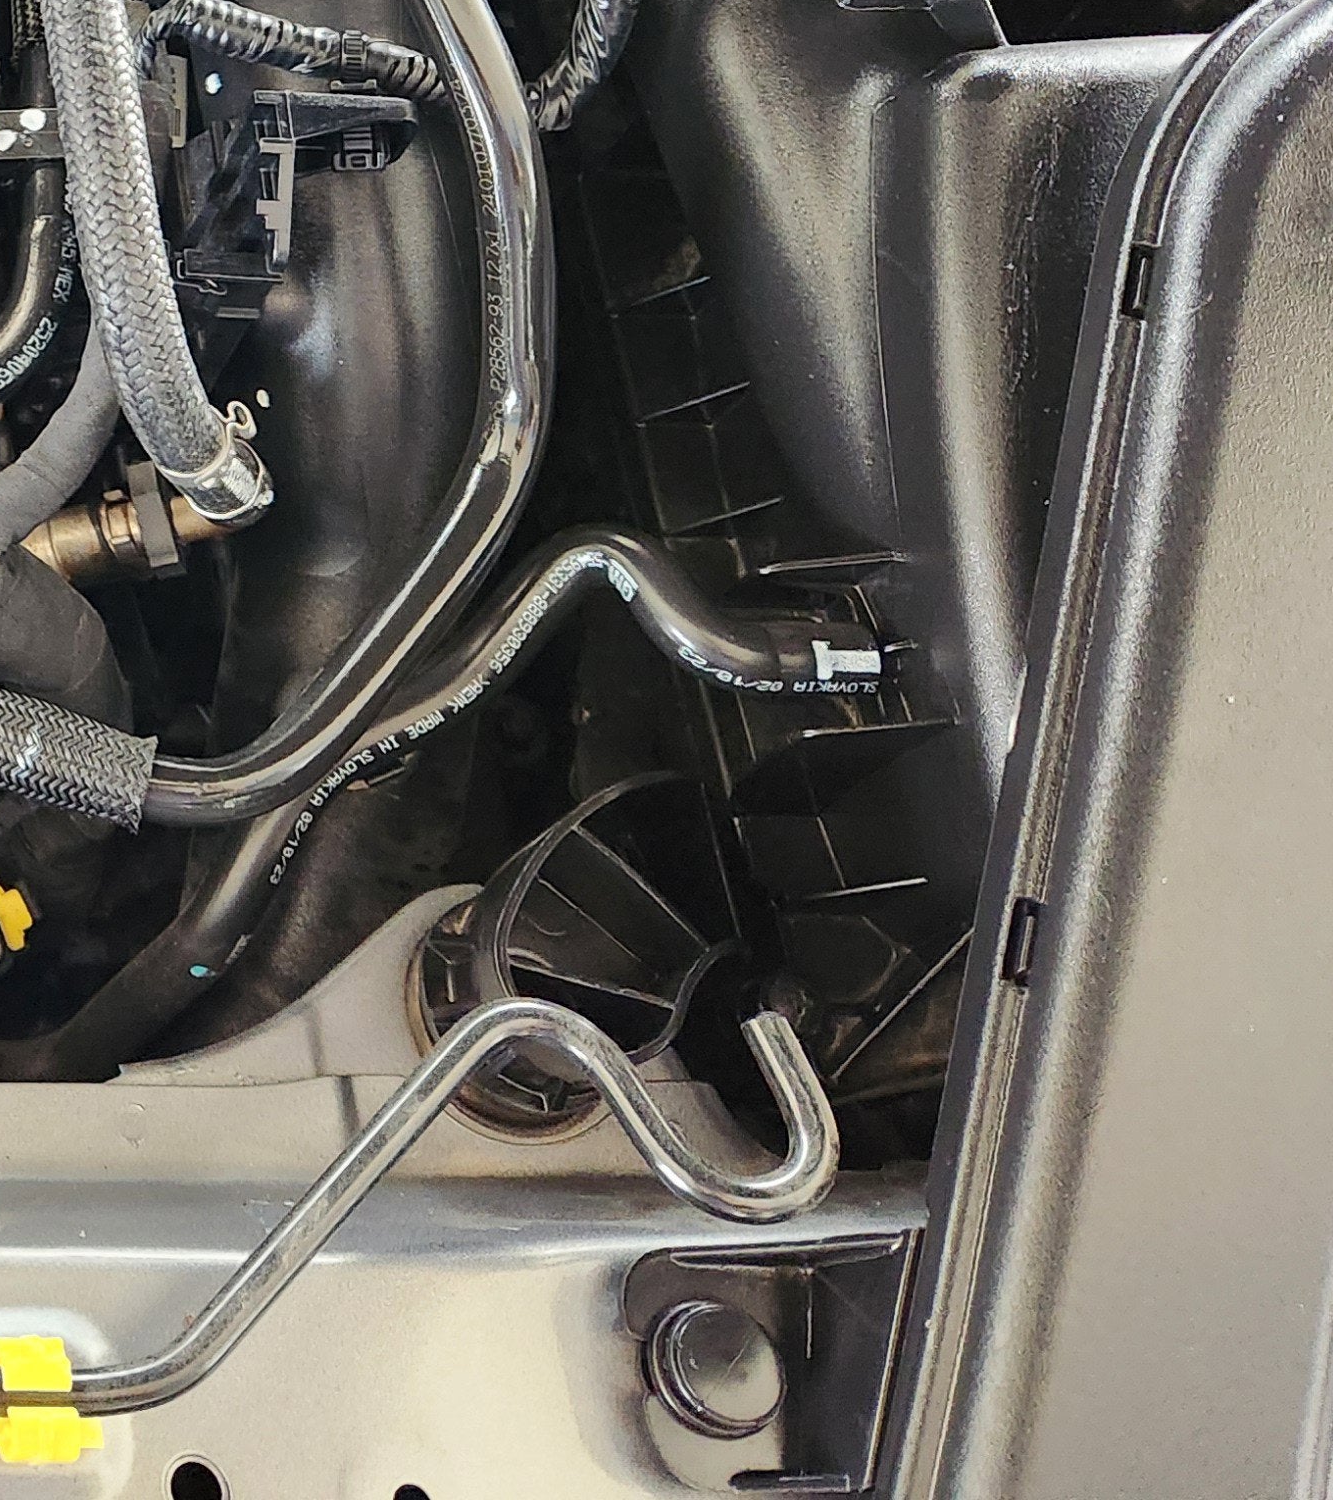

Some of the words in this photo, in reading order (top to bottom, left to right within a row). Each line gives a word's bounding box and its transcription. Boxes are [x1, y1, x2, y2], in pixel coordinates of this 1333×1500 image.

[792, 680, 880, 695] SLOVAKIA
[406, 709, 447, 741] MADE
[379, 736, 400, 756] IN
[308, 747, 376, 808] SLOVAKIA
